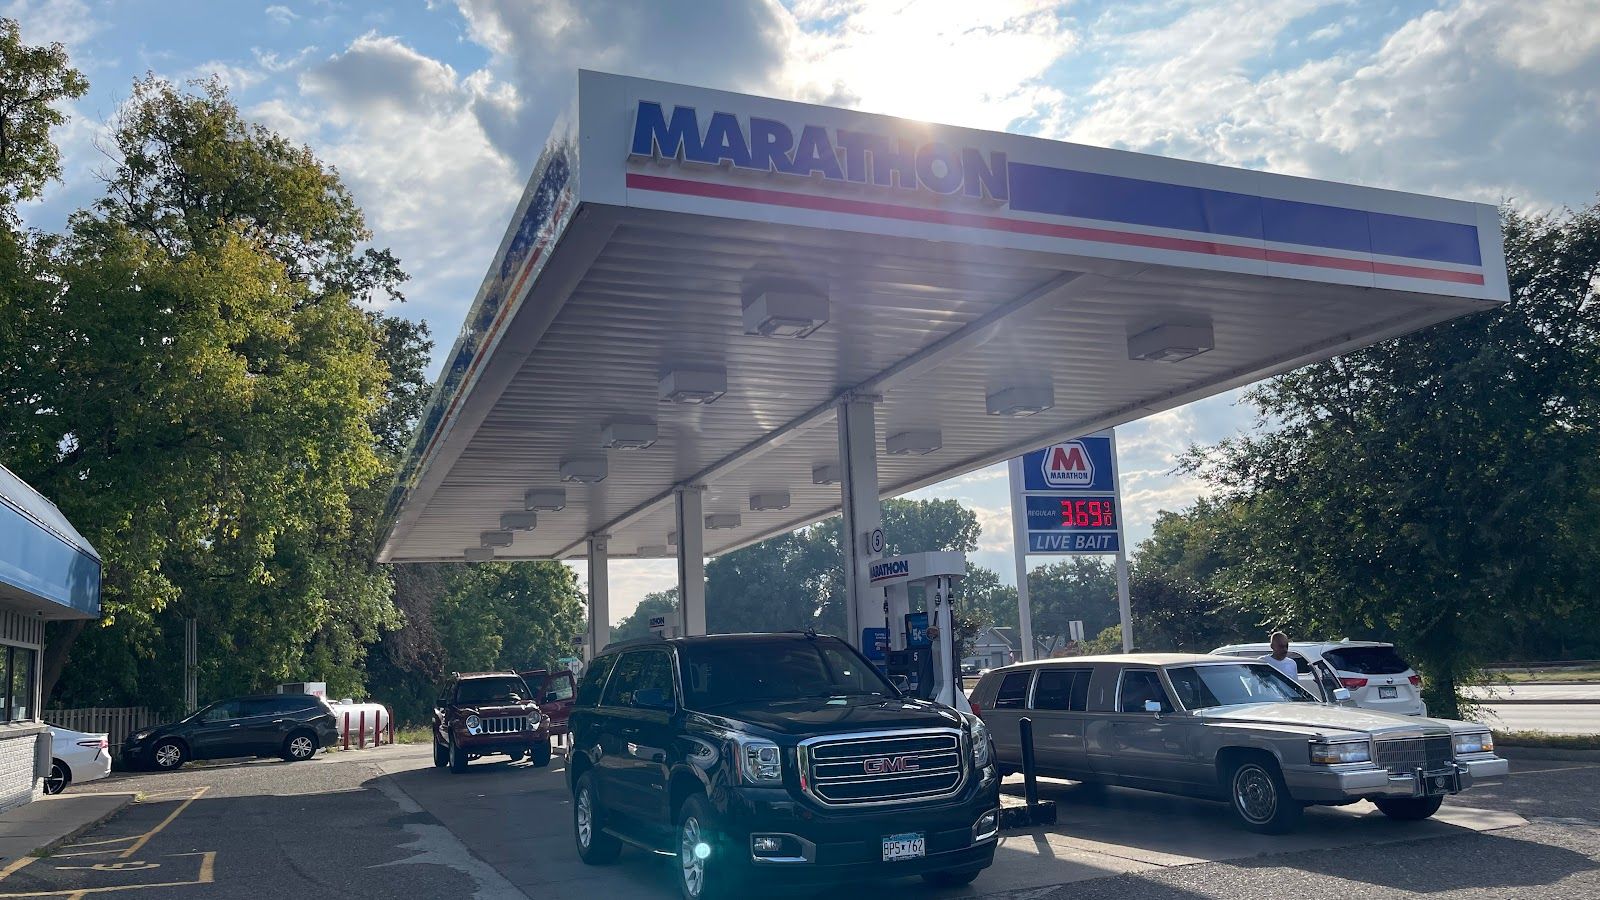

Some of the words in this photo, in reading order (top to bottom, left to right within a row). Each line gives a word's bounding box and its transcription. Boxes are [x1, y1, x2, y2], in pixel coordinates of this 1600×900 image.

[631, 100, 1008, 200] MARATHON
[1052, 448, 1086, 470] M
[1050, 472, 1088, 480] MARATHON
[1061, 500, 1102, 527] 3.69
[875, 536, 880, 547] 5
[1036, 535, 1070, 549] LIVE
[1075, 535, 1111, 549] BAIT
[871, 560, 909, 578] ARATHON
[913, 652, 918, 661] 5
[864, 755, 919, 773] GMC
